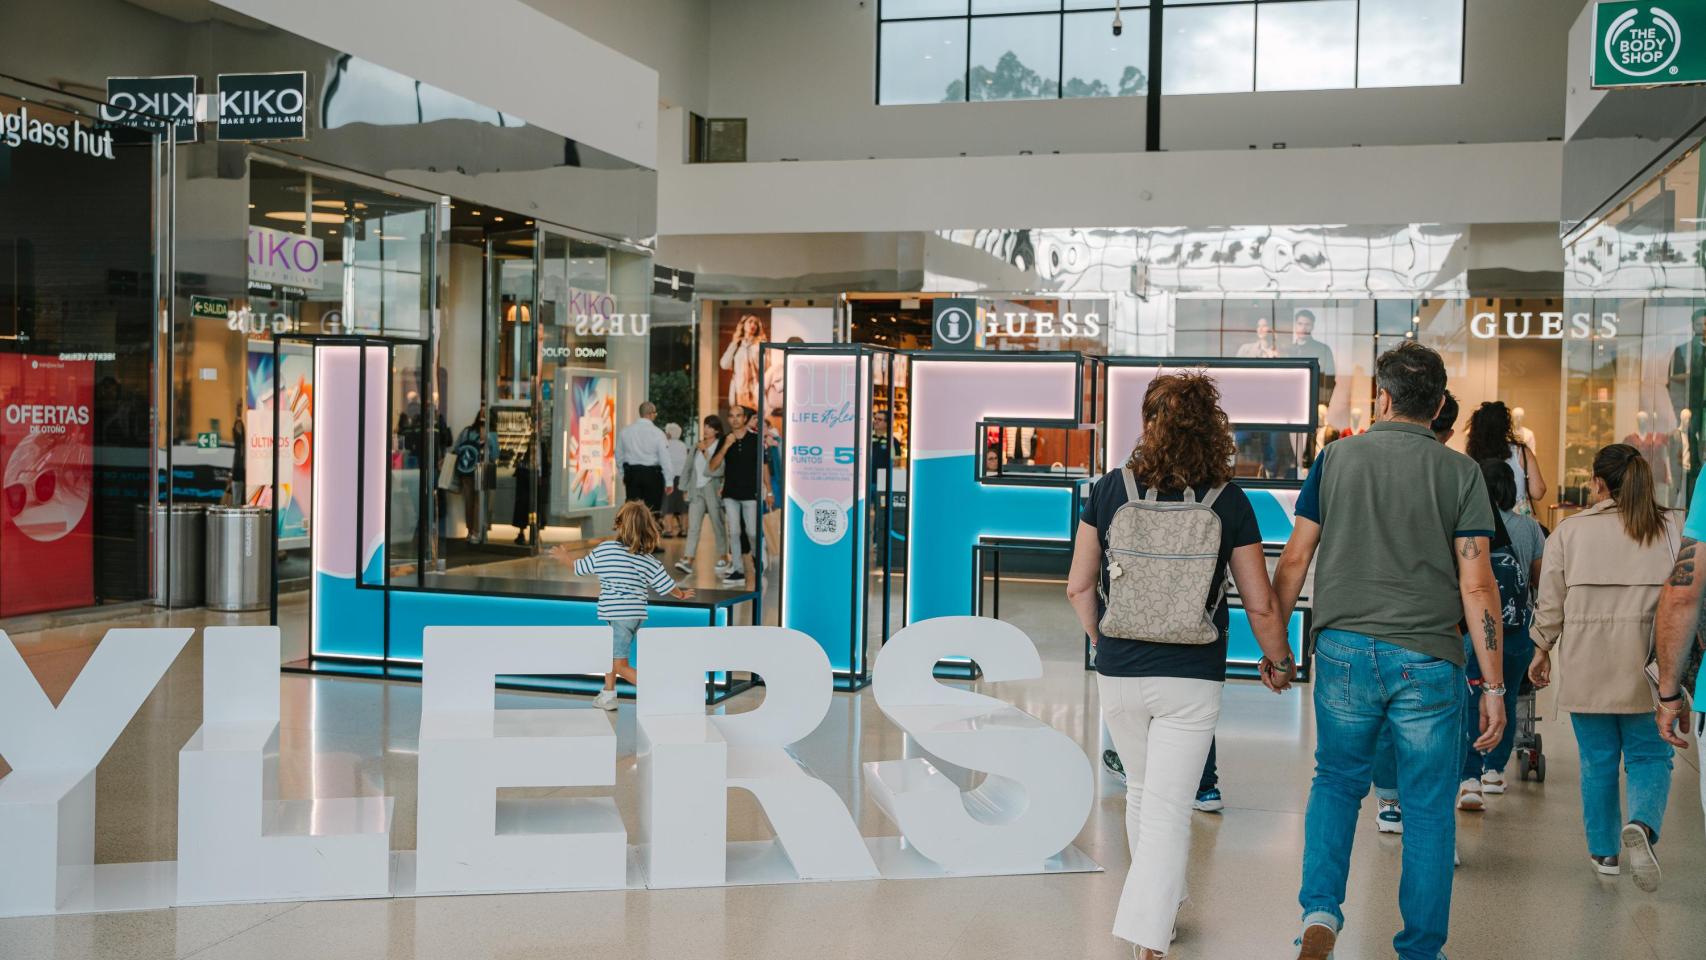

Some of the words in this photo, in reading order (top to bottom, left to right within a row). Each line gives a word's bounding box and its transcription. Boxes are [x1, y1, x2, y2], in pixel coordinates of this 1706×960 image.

[1630, 28, 1656, 39] THE
[1620, 38, 1666, 53] BODY
[1621, 51, 1663, 64] SHOP
[220, 88, 303, 116] KIKO
[220, 117, 245, 125] MAKE
[250, 116, 262, 124] UP
[266, 115, 303, 123] MILANO
[74, 119, 116, 159] hut
[203, 303, 228, 315] SALIDA
[1470, 312, 1618, 339] GUESS
[6, 404, 90, 425] OFERTAS
[791, 412, 819, 423] LIFE
[30, 425, 41, 434] DE
[41, 423, 66, 434] OTOÑO
[792, 445, 823, 456] 150
[791, 456, 823, 464] PUNTOS
